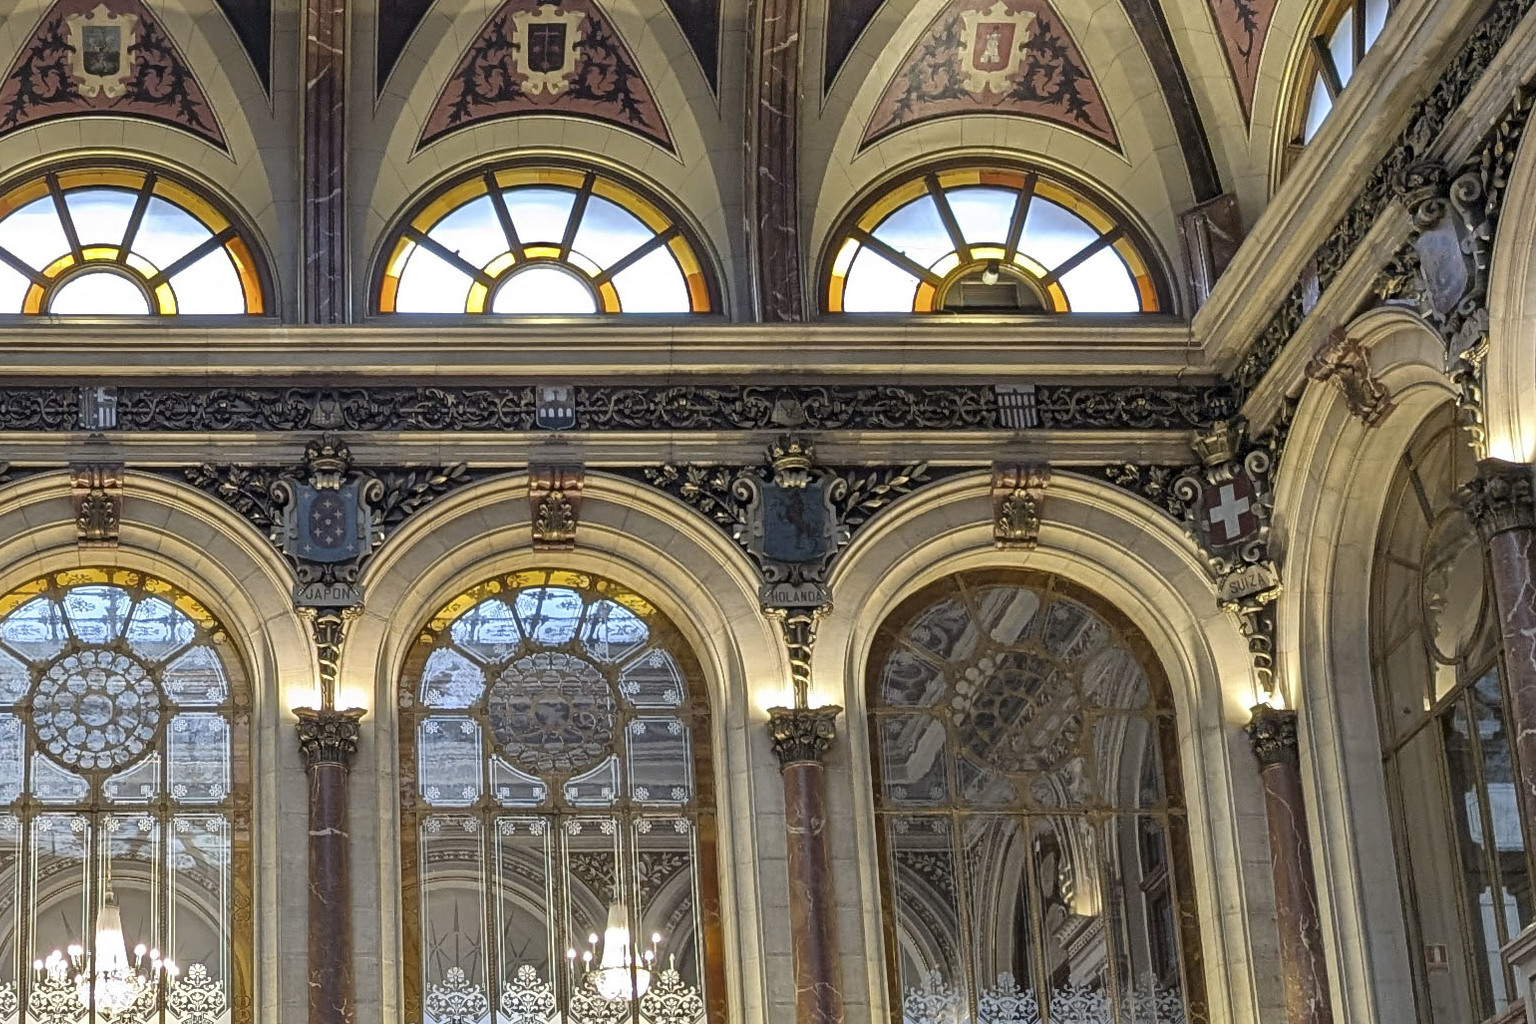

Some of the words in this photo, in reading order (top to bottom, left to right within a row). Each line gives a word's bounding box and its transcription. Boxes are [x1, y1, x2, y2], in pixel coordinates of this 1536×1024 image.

[1229, 572, 1266, 593] SUIZA
[306, 588, 350, 599] JAPON
[771, 592, 822, 602] HOLANDA
